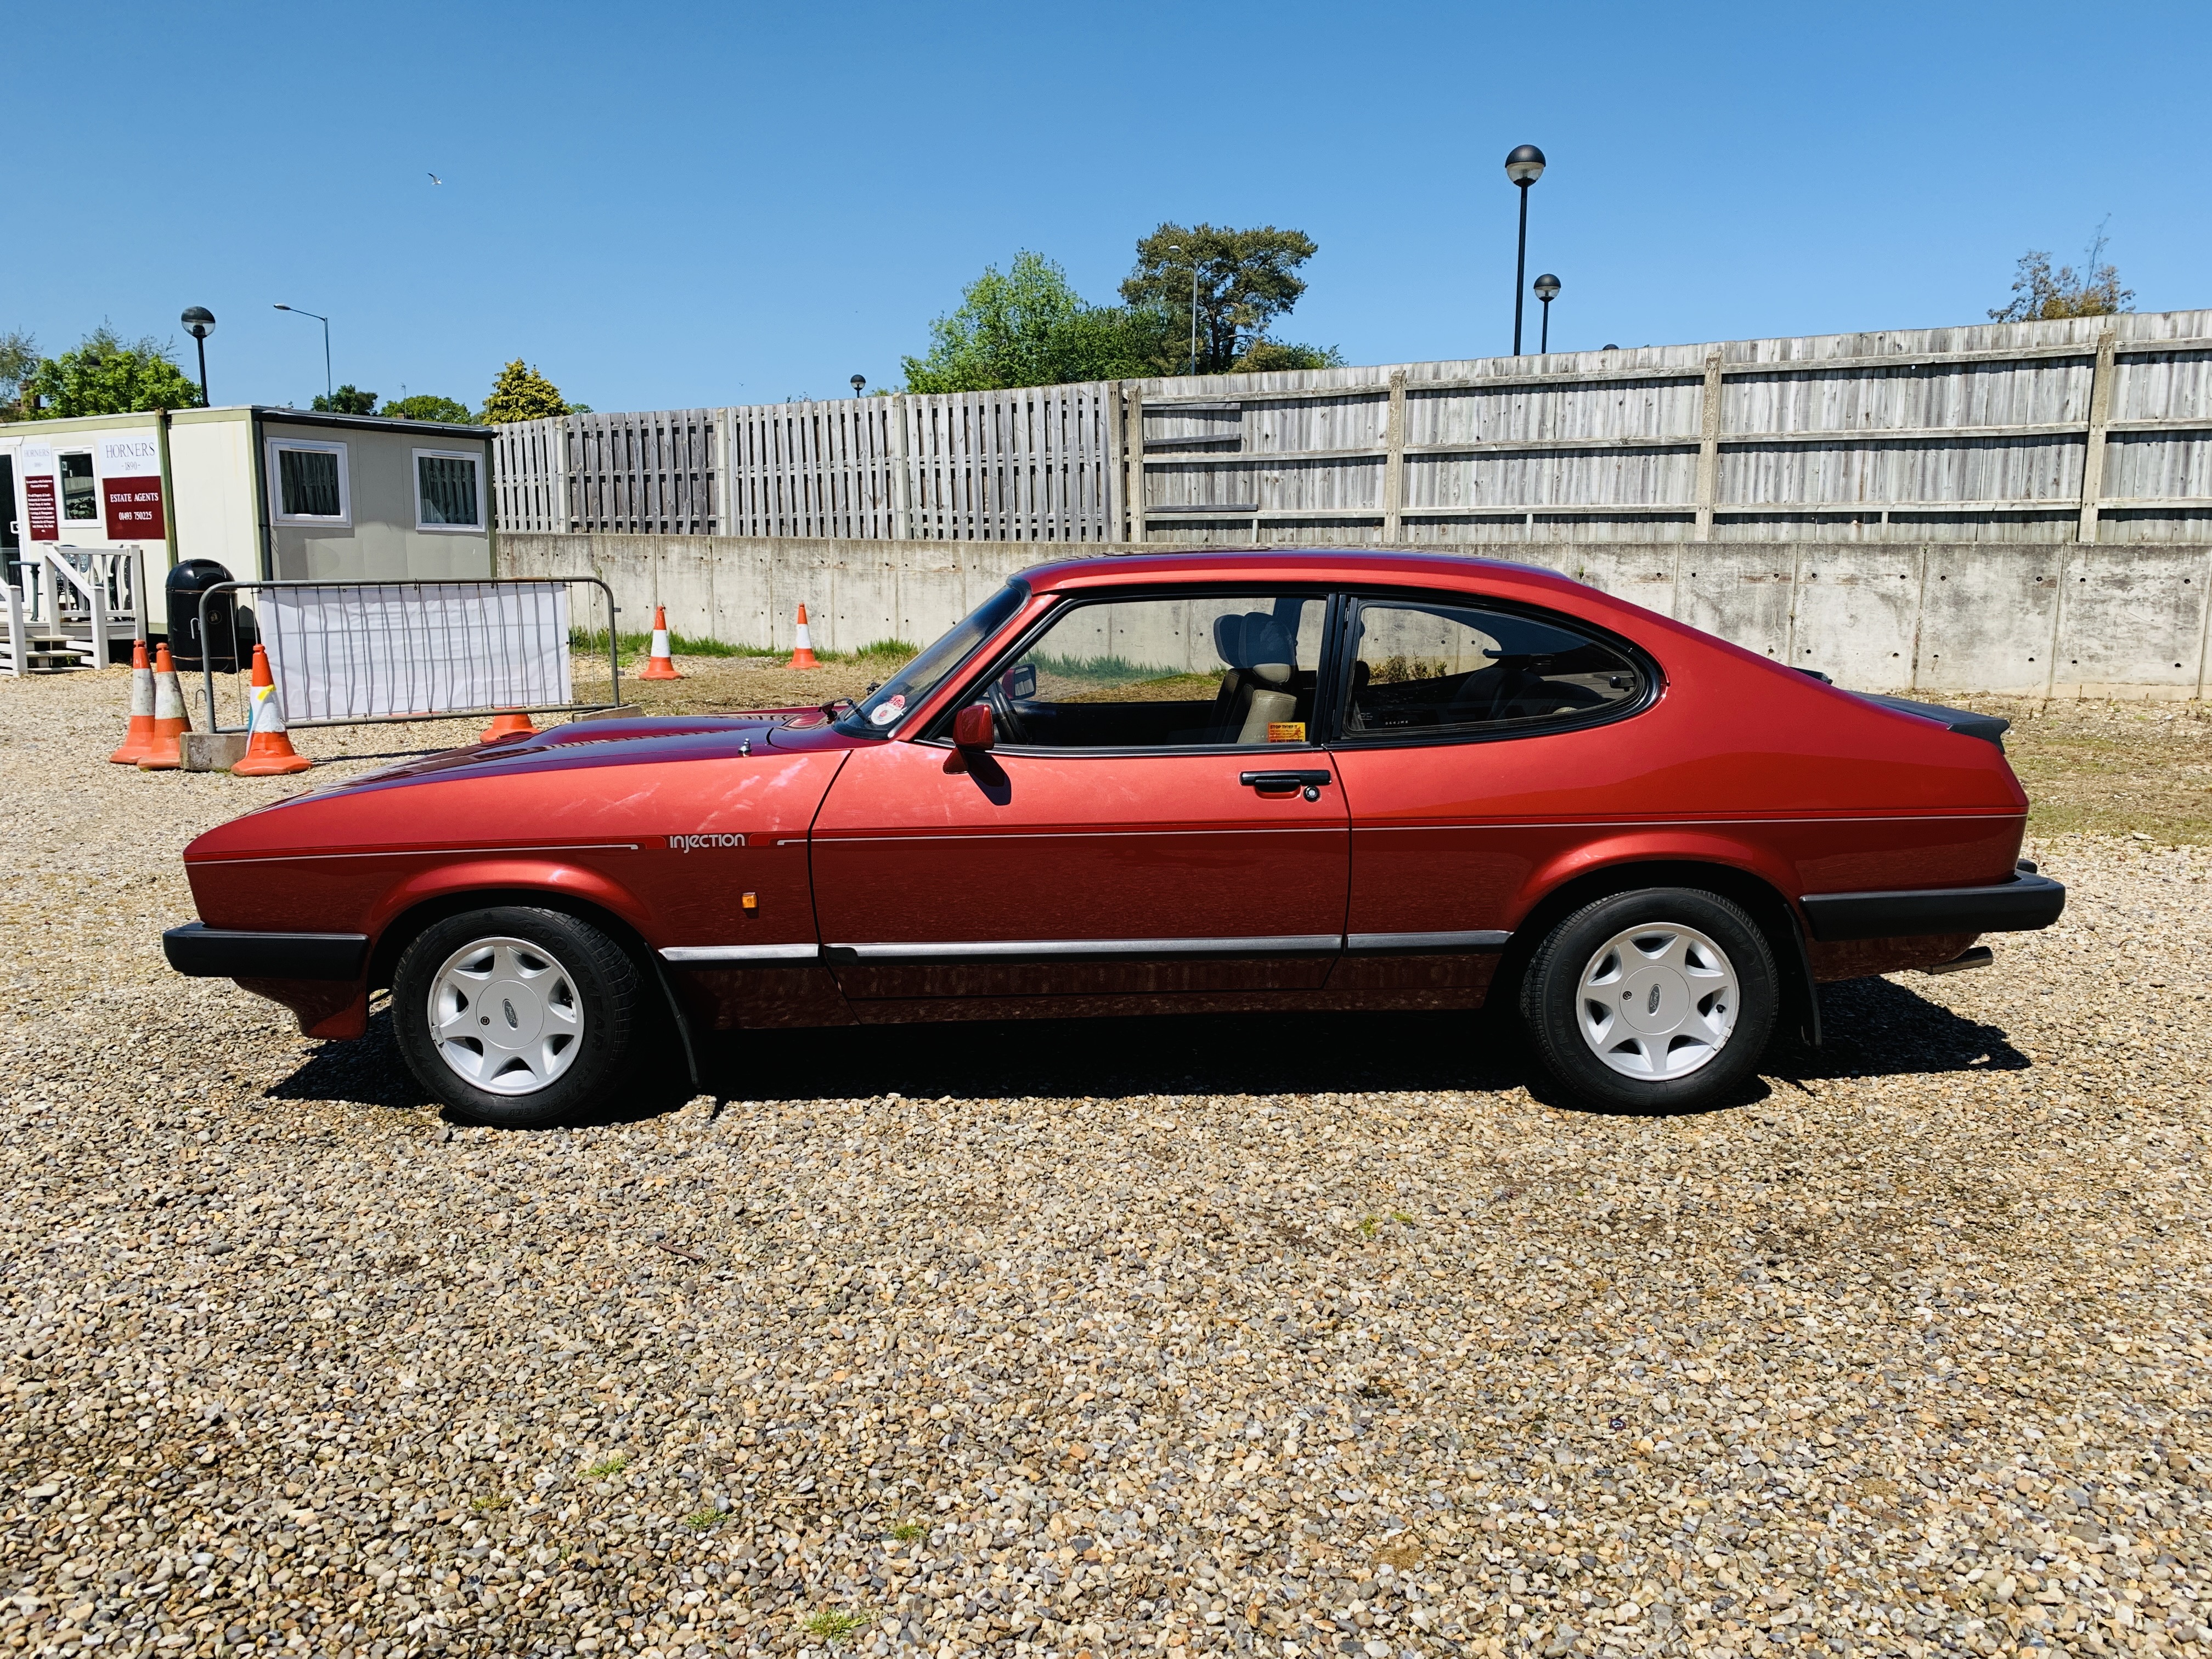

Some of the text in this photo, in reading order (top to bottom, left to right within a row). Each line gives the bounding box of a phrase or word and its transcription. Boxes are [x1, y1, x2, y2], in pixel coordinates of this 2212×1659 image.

[24, 448, 50, 458] HORNERS
[106, 442, 155, 458] HORNERS
[110, 493, 159, 503] ESTATE AGENTS
[119, 511, 152, 521] 01493 750225
